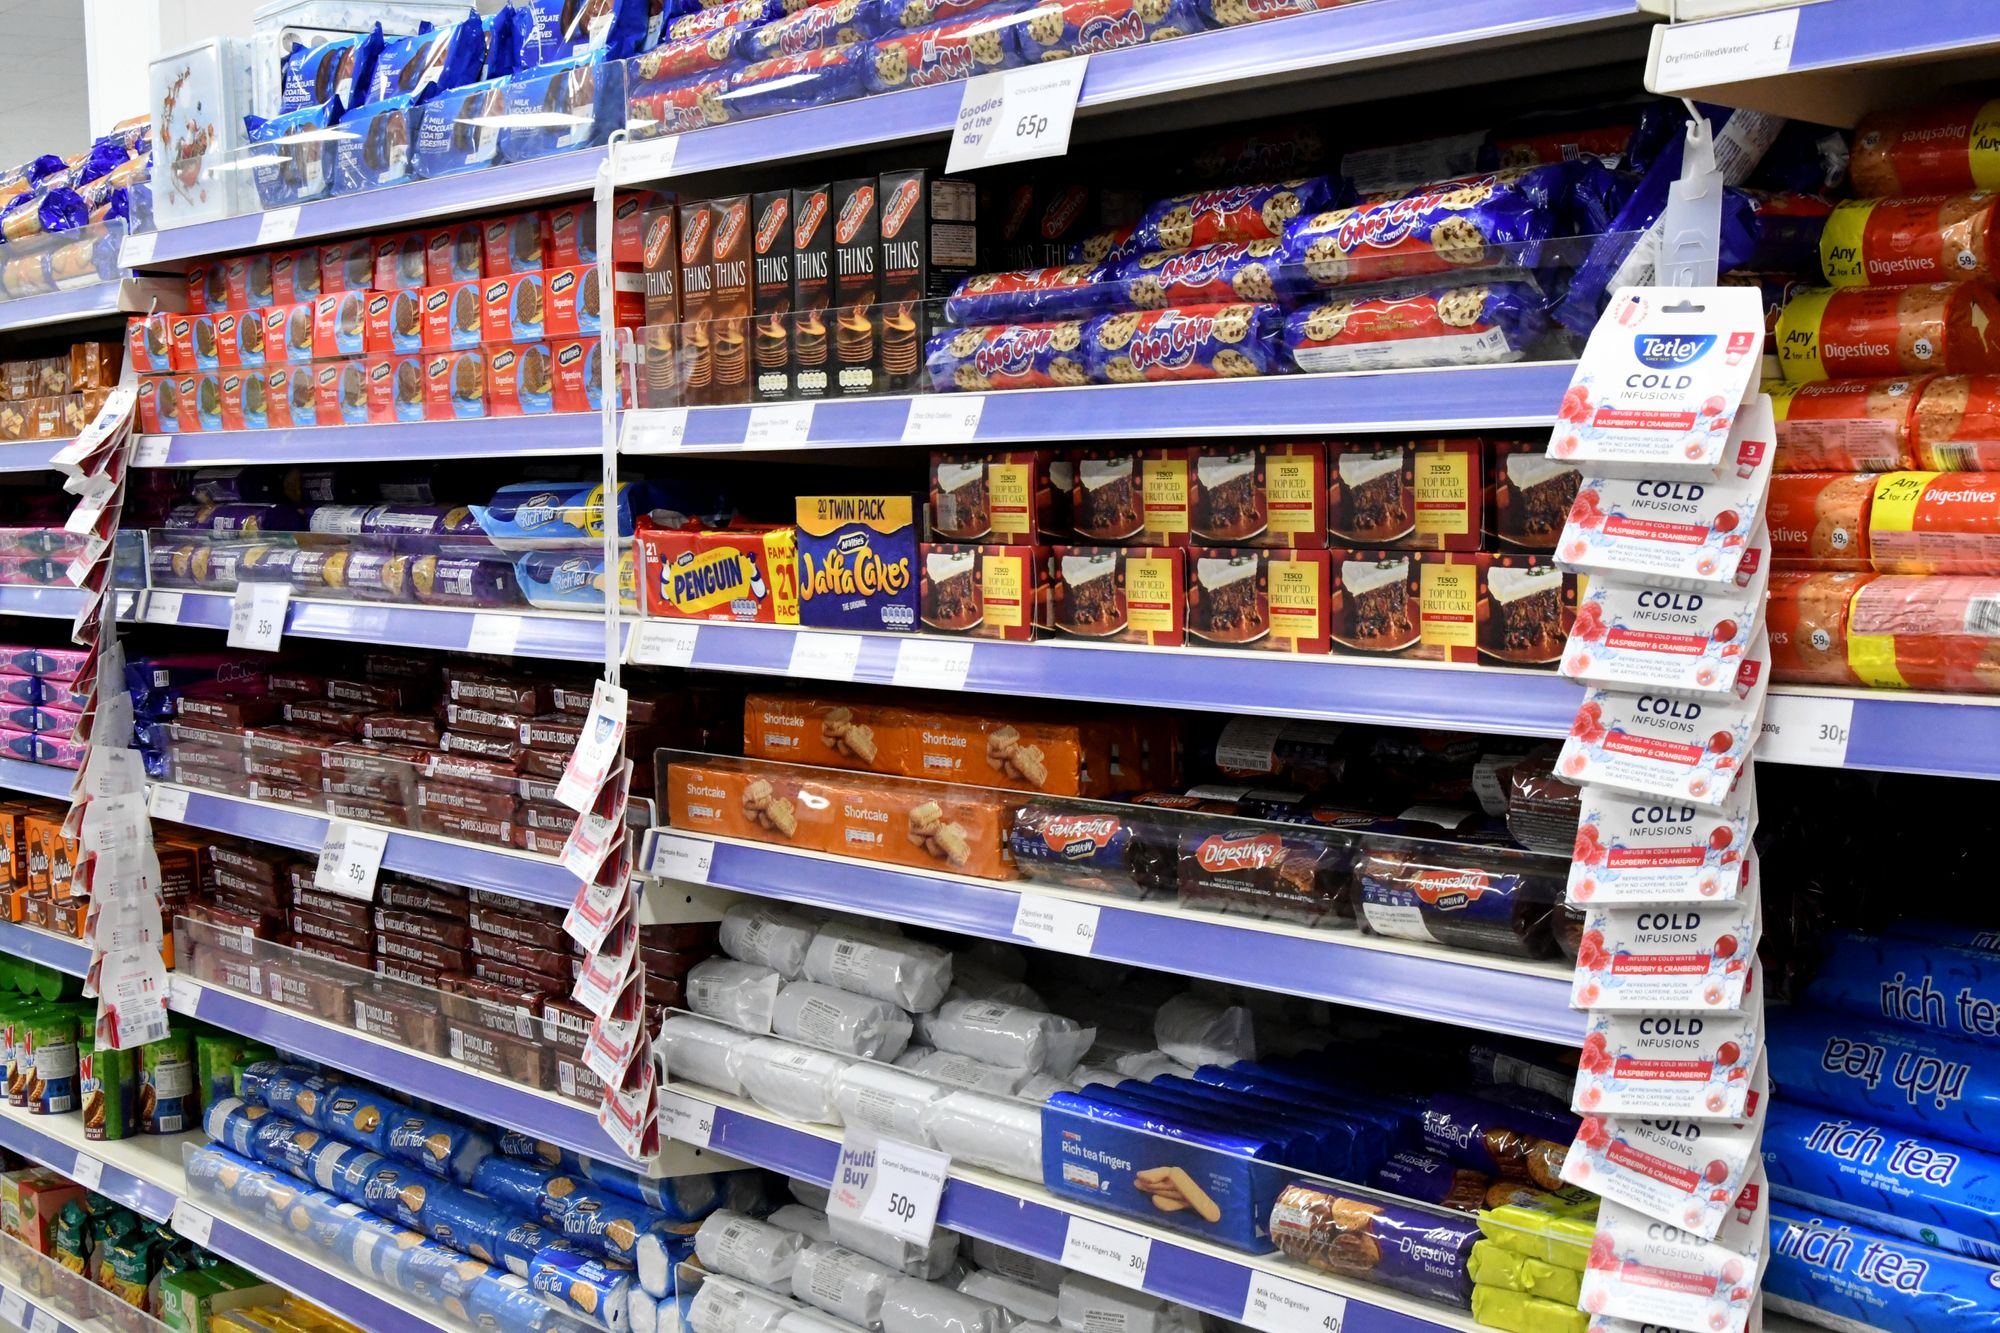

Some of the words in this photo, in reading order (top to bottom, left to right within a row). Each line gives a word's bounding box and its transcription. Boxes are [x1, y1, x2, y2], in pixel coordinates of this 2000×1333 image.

[960, 96, 1003, 120] Goodies
[962, 118, 975, 131] of
[975, 114, 993, 129] the
[1016, 114, 1048, 139] 65p
[963, 133, 982, 146] day
[1337, 210, 1391, 253] Choc
[1391, 194, 1444, 224] Chip
[1382, 222, 1408, 242] COOKIES
[837, 246, 873, 275] THINS
[883, 240, 919, 270] THINS
[1829, 246, 1857, 263] Any
[714, 260, 746, 289] THINS
[756, 256, 788, 285] THINS
[796, 251, 828, 280] THINS
[1869, 256, 1936, 275] Digestives
[1130, 333, 1172, 371] Choc
[1173, 316, 1213, 350] Chip
[1736, 335, 1745, 346] 3
[1785, 330, 1814, 346] Any
[975, 340, 1013, 376] Choc
[1014, 328, 1052, 360] Chip
[1642, 338, 1705, 363] Tetley
[1783, 346, 1791, 360] 2
[1792, 352, 1803, 360] for
[1806, 345, 1818, 360] £1
[1825, 342, 1890, 361] Digestives
[1915, 344, 1932, 355] 59p
[1626, 374, 1692, 390] COLD
[1747, 446, 1756, 456] 3
[1430, 464, 1451, 472] TESCO
[1149, 482, 1161, 492] TOP
[1163, 482, 1181, 491] ICED
[1273, 479, 1287, 488] TOP
[1288, 479, 1306, 488] ICED
[1422, 477, 1437, 486] TOP
[1438, 477, 1459, 487] ICED
[1636, 480, 1704, 501] COLD
[1144, 492, 1165, 502] FRUIT
[1165, 493, 1185, 502] CAKE
[1268, 489, 1290, 499] FRUIT
[1291, 490, 1312, 499] CAKE
[1416, 488, 1439, 498] FRUIT
[1441, 488, 1465, 498] CAKE
[1878, 488, 1890, 500] 2
[1889, 493, 1901, 501] for
[1903, 489, 1920, 501] £1
[1925, 488, 1997, 506] Digestives
[818, 499, 827, 513] 20
[828, 499, 855, 520] TWIN
[858, 499, 885, 520] PACK
[1631, 499, 1698, 514] INFUSIONS
[1622, 519, 1644, 527] INFUSE
[1653, 521, 1671, 529] COLD
[1671, 523, 1694, 531] WATER
[1606, 526, 1651, 538] RASPBERRY
[1651, 530, 1657, 538] &
[1657, 531, 1703, 543] CRANBERRY
[1833, 532, 1847, 544] 59p
[646, 542, 657, 556] 21
[674, 554, 743, 604] PENGUIN
[775, 563, 797, 600] 21
[801, 548, 855, 601] Jaffa
[854, 546, 910, 597] Cakes
[1637, 590, 1703, 611] COLD
[1632, 610, 1698, 624] INFUSIONS
[257, 619, 272, 638] 35p
[1608, 638, 1651, 648] RASPBERRY
[1651, 641, 1657, 649] &
[1658, 642, 1702, 654] CRANBERRY
[1813, 632, 1829, 646] 59p
[1637, 695, 1702, 720] COLD
[764, 712, 805, 728] Shortcake
[1631, 715, 1695, 733] INFUSIONS
[531, 730, 558, 743] CHOCOLATE
[558, 733, 576, 745] CREAMS
[922, 731, 967, 749] Shortcake
[1818, 723, 1847, 743] 30p
[687, 783, 726, 799] Shortcake
[844, 805, 889, 823] Shortcake
[1631, 805, 1696, 824] COLD
[1629, 826, 1692, 837] INFUSIONS
[324, 841, 345, 850] Goodies
[1203, 842, 1275, 867] Digestives
[349, 863, 365, 884] 35p
[1021, 908, 1042, 919] Digestive
[1076, 923, 1094, 940] 60p
[1634, 933, 1698, 943] INFUSIONS
[281, 976, 306, 996] CHOCOLATE
[366, 1005, 393, 1025] CHOCOLATE
[463, 1033, 493, 1056] CHOCOLATE
[559, 1031, 576, 1045] CREAMS
[463, 1051, 480, 1064] CREAMS
[1822, 1036, 1886, 1090] tea
[1893, 1050, 1971, 1110] rich
[577, 1085, 595, 1100] CREAMS
[390, 1129, 408, 1147] Rich
[407, 1132, 425, 1147] Tea
[1423, 1121, 1470, 1150] Digestive
[842, 1149, 876, 1168] Multi
[1062, 1141, 1082, 1157] Rich
[1082, 1146, 1099, 1161] tea
[1099, 1151, 1132, 1171] fingers
[1805, 1119, 1882, 1165] rich
[1888, 1140, 1960, 1187] tea
[882, 1158, 900, 1168] Caramel
[843, 1167, 869, 1189] Buy
[1861, 1177, 1870, 1185] for
[1880, 1182, 1890, 1192] the
[365, 1180, 383, 1199] Rich
[382, 1183, 399, 1199] Tea
[888, 1192, 916, 1222] 50p
[564, 1212, 585, 1234] Rich
[586, 1216, 605, 1235] Tea
[1071, 1238, 1081, 1247] Rich
[1081, 1241, 1091, 1250] Tea
[1092, 1245, 1109, 1256] Fingers
[1400, 1236, 1456, 1267] Digestive
[1776, 1218, 1855, 1275] rich
[1857, 1240, 1929, 1296] tea
[1424, 1261, 1454, 1279] biscuits
[1256, 1287, 1268, 1296] Milk
[1269, 1291, 1283, 1303] Choc
[1284, 1297, 1310, 1312] Digestive
